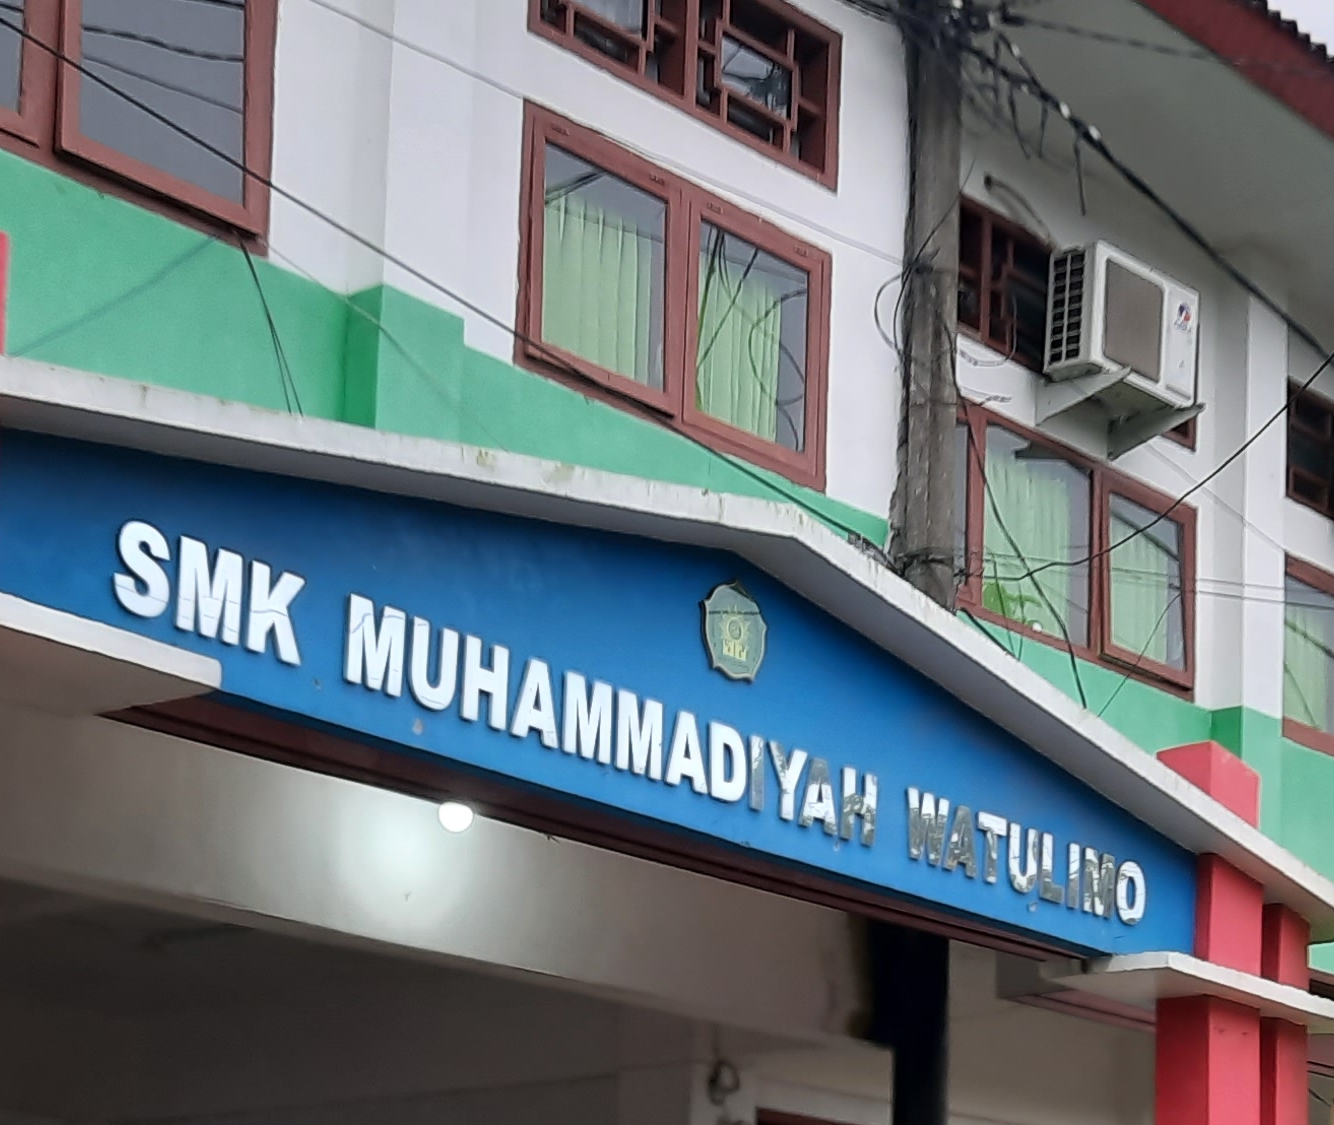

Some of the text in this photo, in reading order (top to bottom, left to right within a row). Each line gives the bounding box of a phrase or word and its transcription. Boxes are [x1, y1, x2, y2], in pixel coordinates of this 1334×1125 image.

[113, 519, 1147, 926] SMK MUHAMMADIYAH WATULIMO
